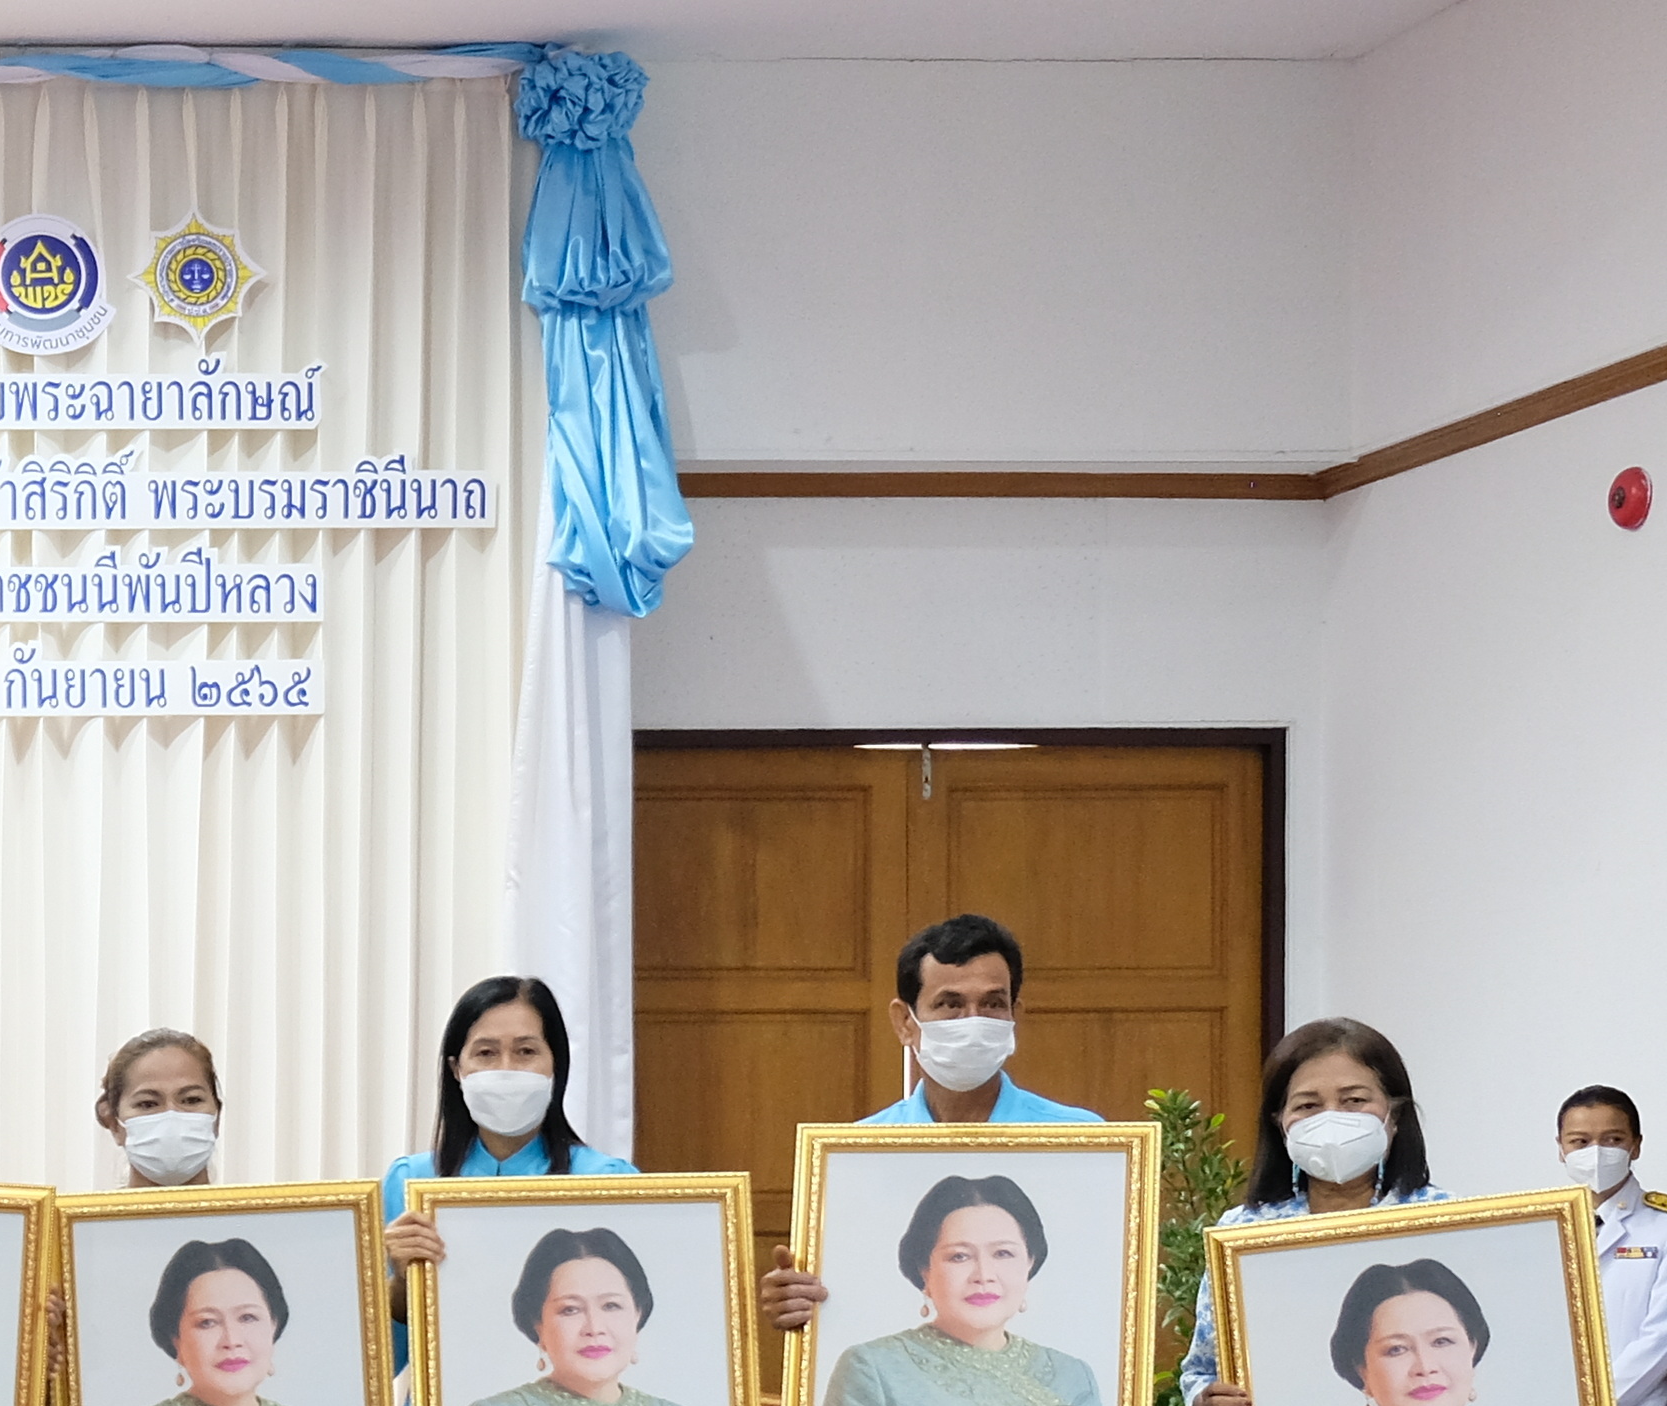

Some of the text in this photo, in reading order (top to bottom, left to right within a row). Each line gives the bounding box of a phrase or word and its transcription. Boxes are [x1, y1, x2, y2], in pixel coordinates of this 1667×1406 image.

[148, 454, 488, 522] พระบรมราชินีนาถ
[4, 647, 168, 711] กันยายน
[189, 662, 313, 710] ๒๕๖๕
